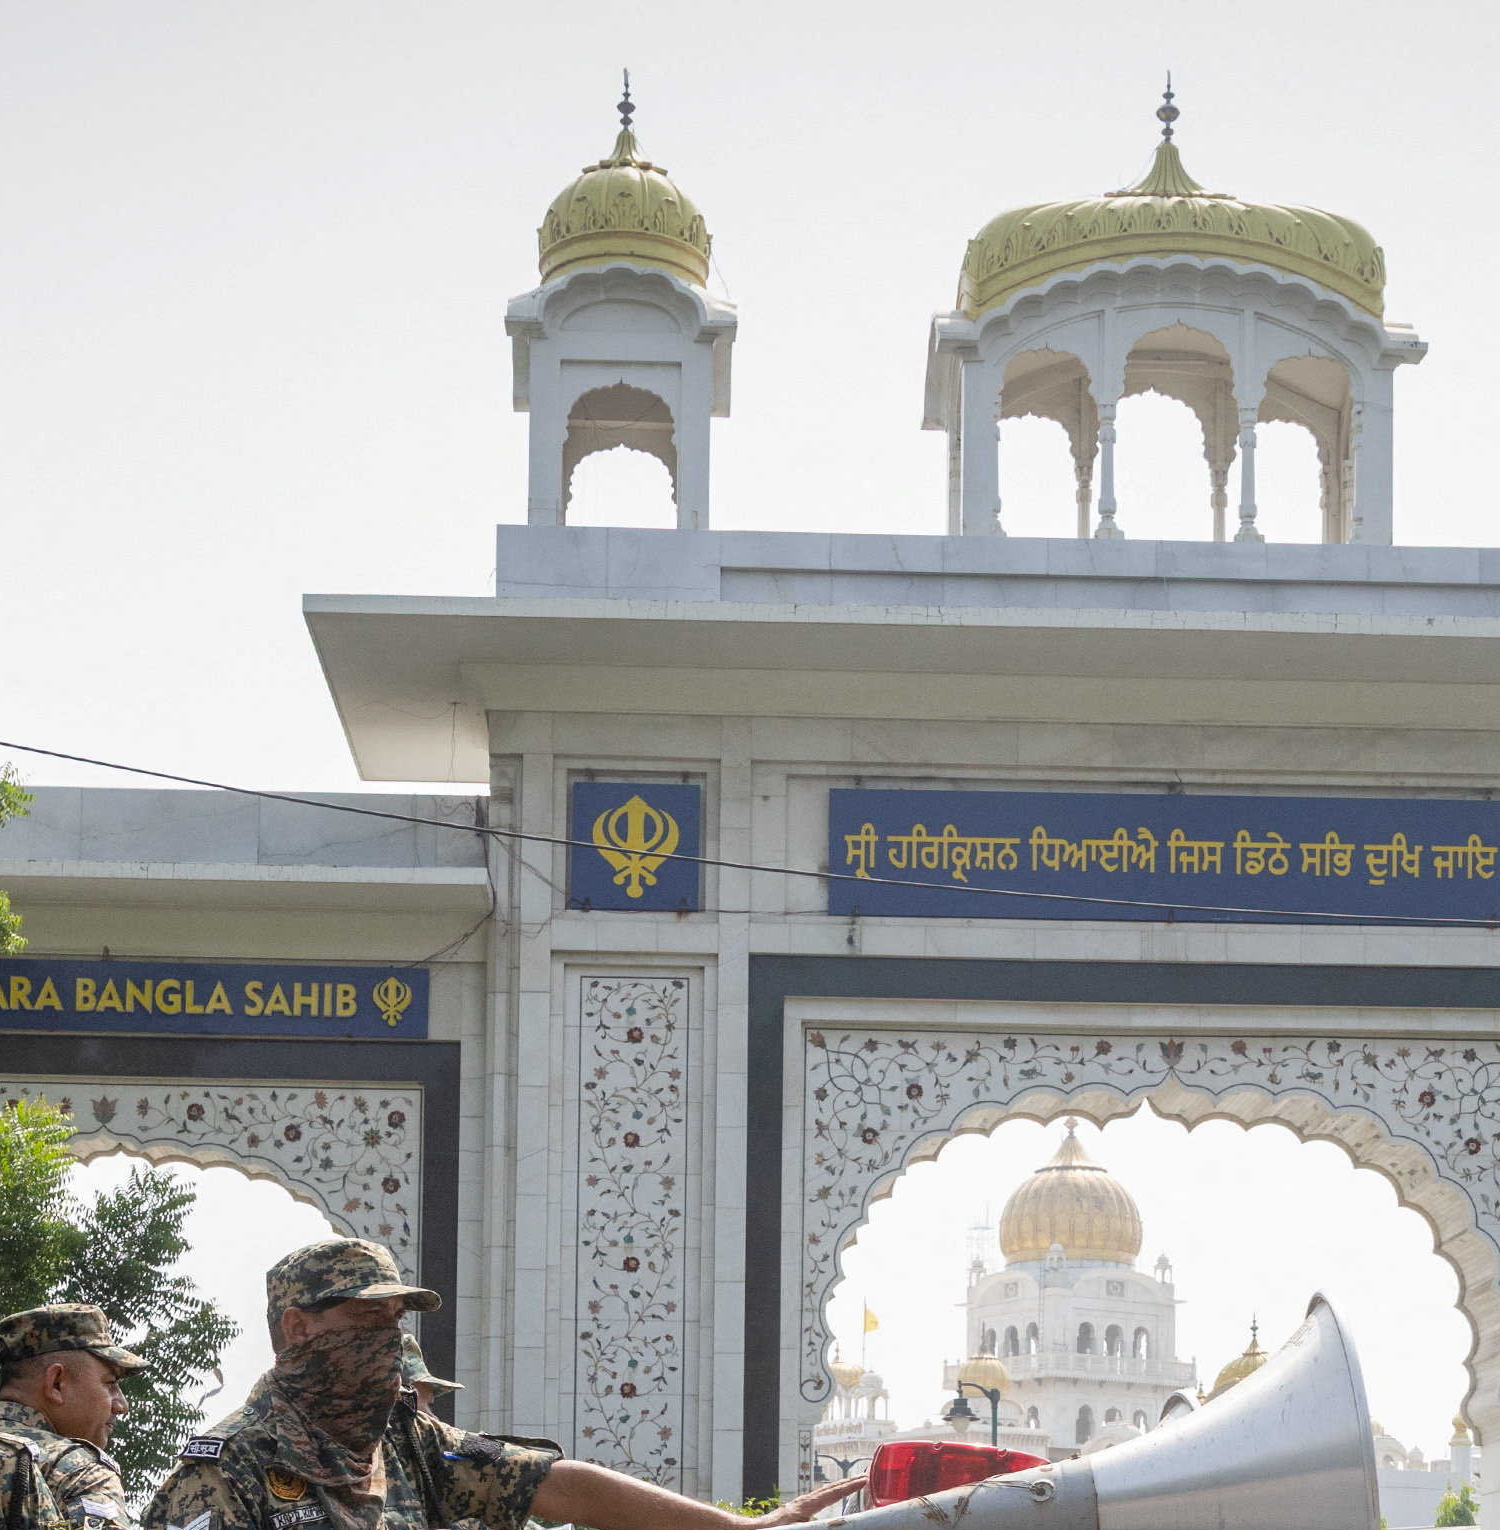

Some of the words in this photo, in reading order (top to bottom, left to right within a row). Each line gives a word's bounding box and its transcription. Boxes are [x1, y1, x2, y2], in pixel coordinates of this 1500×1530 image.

[844, 822, 879, 879] ਸ੍ਰੀ
[887, 823, 1021, 883] ਹਰਿਕ੍ਰਿਸ਼ਨ
[1028, 825, 1160, 873] ਧਿਆਈਐ
[1167, 828, 1225, 874] ਜਿਸ
[1233, 829, 1292, 875] ਡਿਠੇ
[1300, 831, 1356, 877] ਸਭਿ
[1364, 832, 1423, 886] ਦੁਖਿ
[1432, 834, 1499, 879] ਜਾਇ
[75, 977, 232, 1015] BANGLA
[245, 981, 357, 1018] SAHIB
